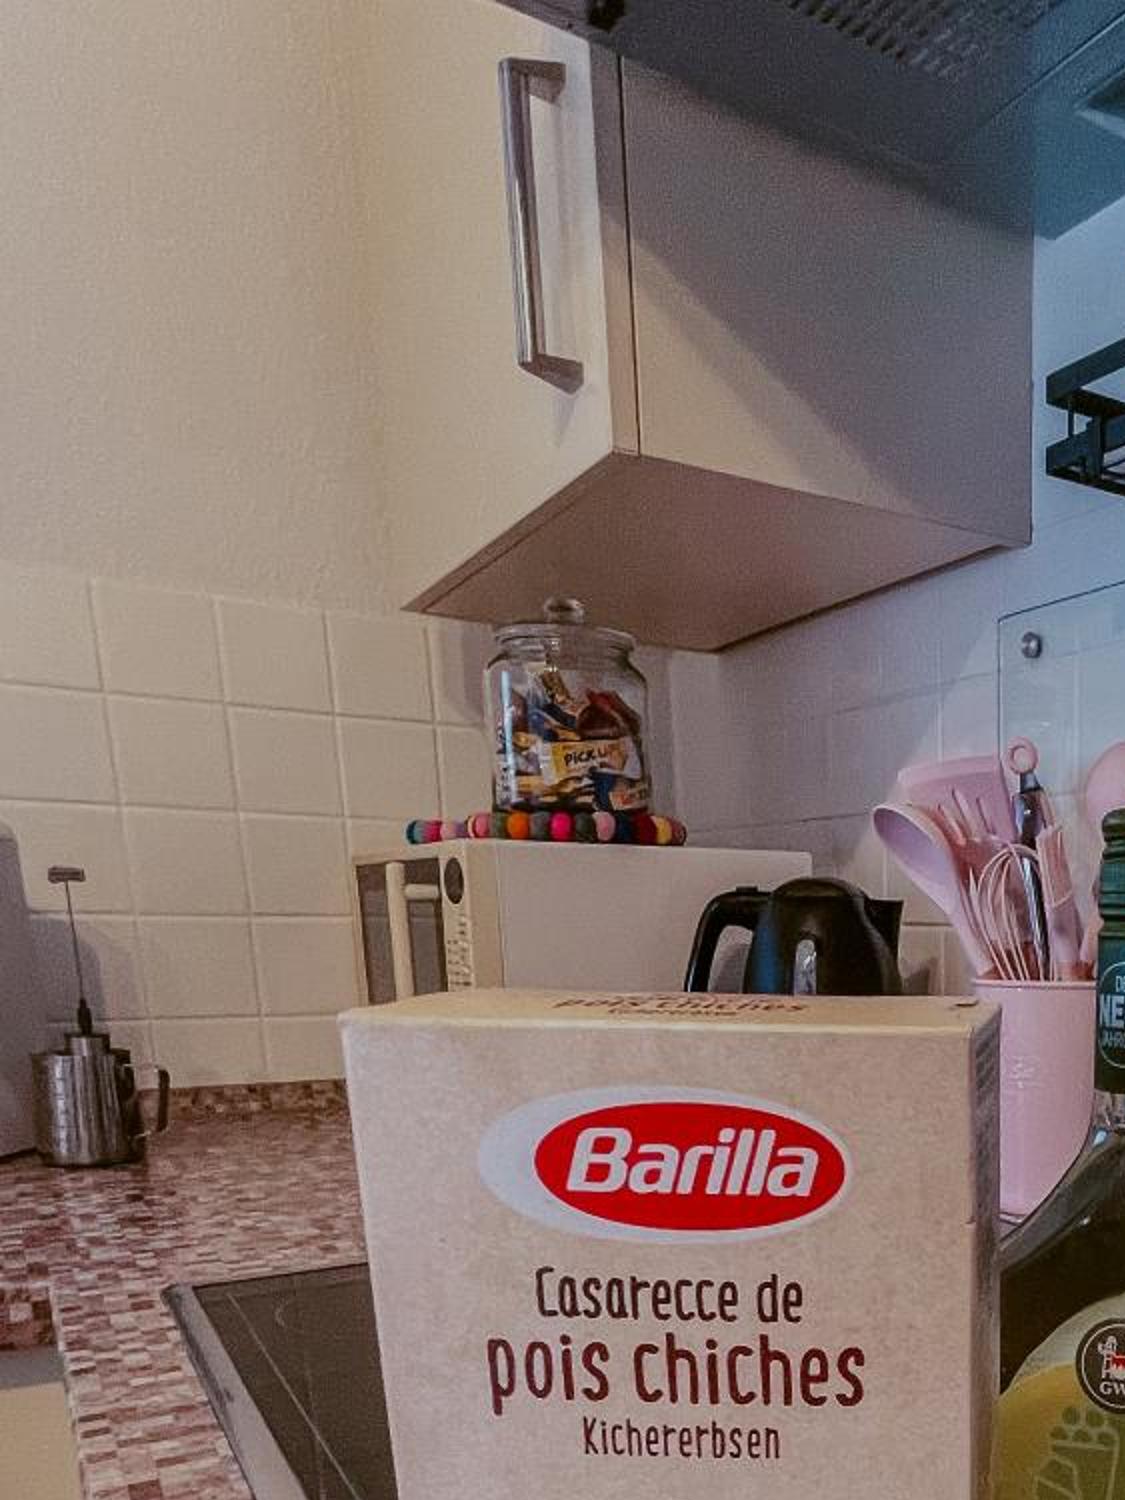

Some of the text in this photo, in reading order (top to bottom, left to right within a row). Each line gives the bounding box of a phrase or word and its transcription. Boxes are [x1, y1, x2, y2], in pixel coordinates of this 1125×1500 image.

[565, 1127, 820, 1197] Barilla
[536, 1267, 804, 1323] Casarecce de
[486, 1333, 866, 1416] pois chiches
[583, 1416, 781, 1459] Kichererbsen
